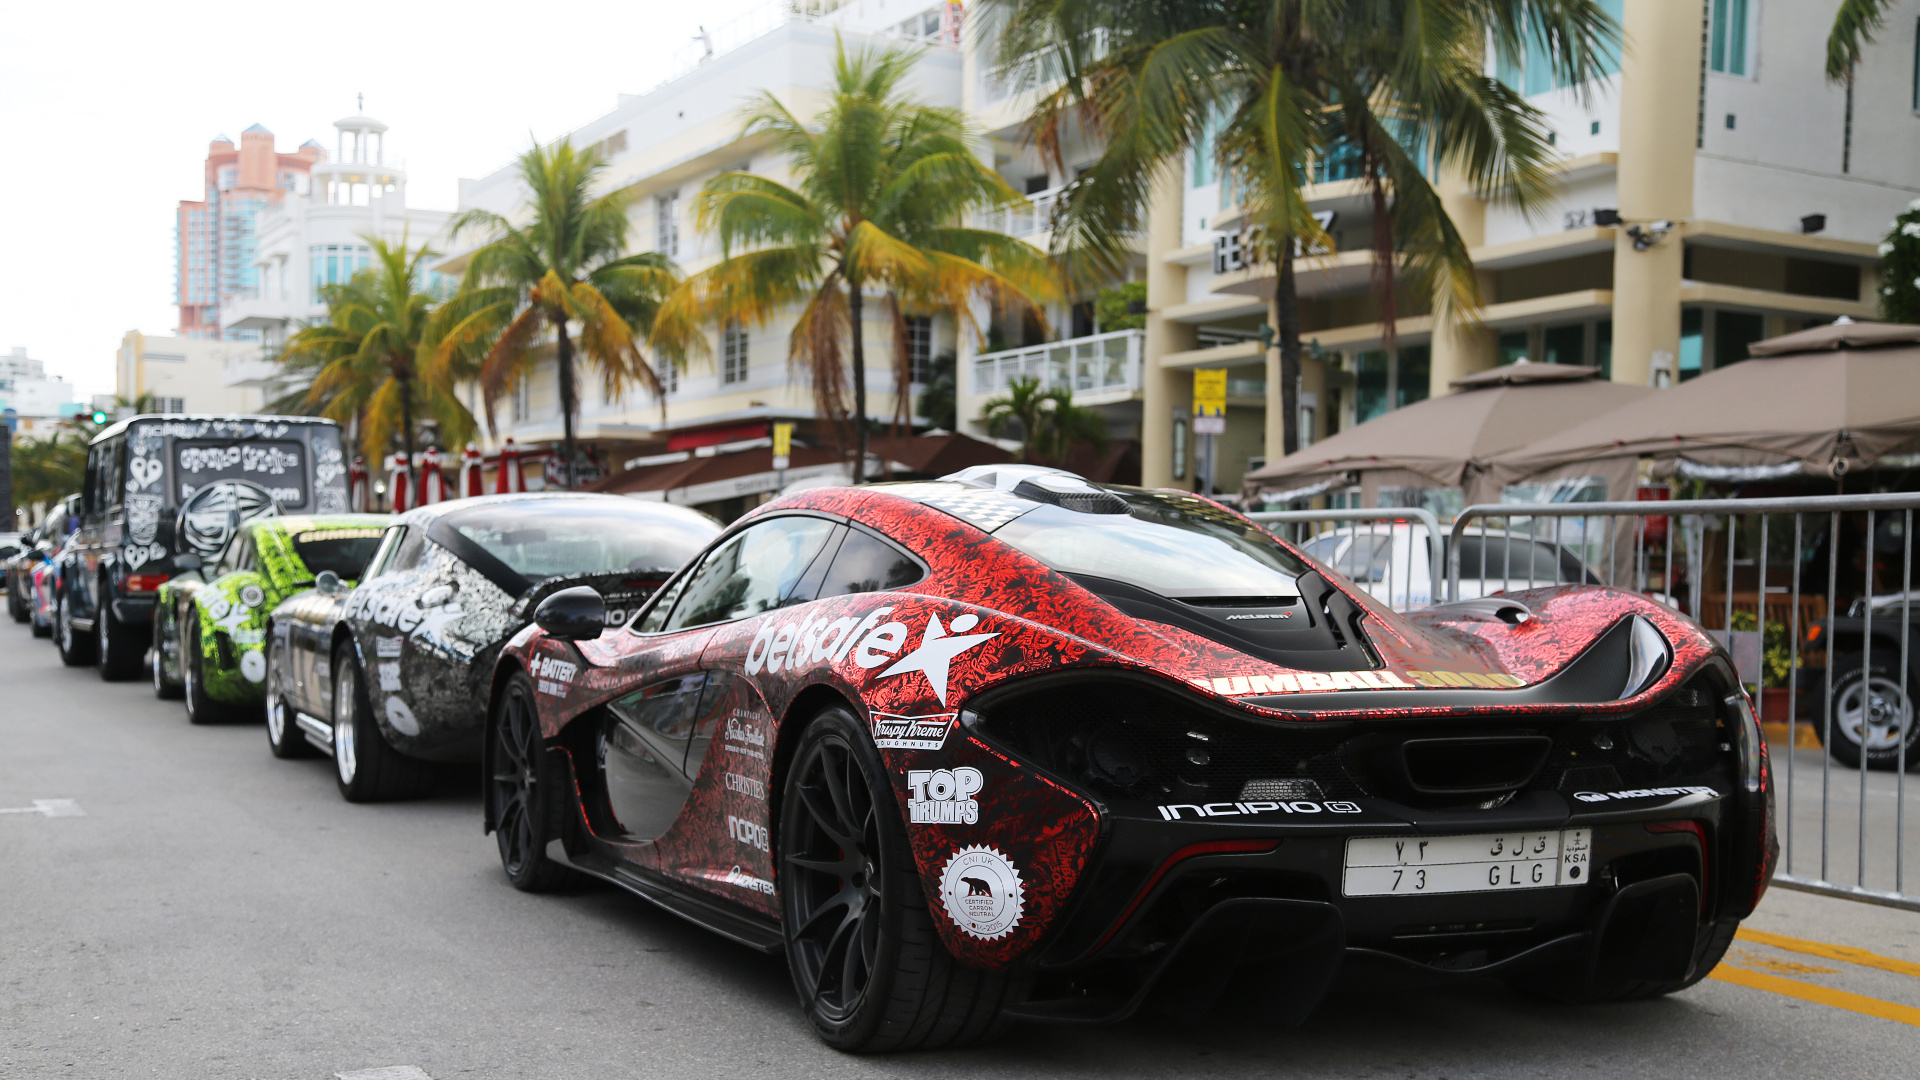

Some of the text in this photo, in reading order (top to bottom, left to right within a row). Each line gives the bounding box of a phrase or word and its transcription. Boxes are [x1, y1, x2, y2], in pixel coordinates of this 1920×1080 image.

[744, 606, 908, 676] betsafe
[540, 657, 578, 683] BATTERY
[1406, 671, 1527, 687] 3000
[873, 719, 948, 740] Krispy Kreme
[876, 740, 939, 748] DOUGHNUTS
[908, 766, 984, 804] TOP
[1607, 786, 1720, 800] MONSTER
[908, 798, 979, 825] TRUMPS
[1157, 801, 1322, 821] INCIPIO
[980, 855, 994, 866] UK
[1564, 853, 1587, 863] KSA
[735, 873, 776, 896] MONSTER
